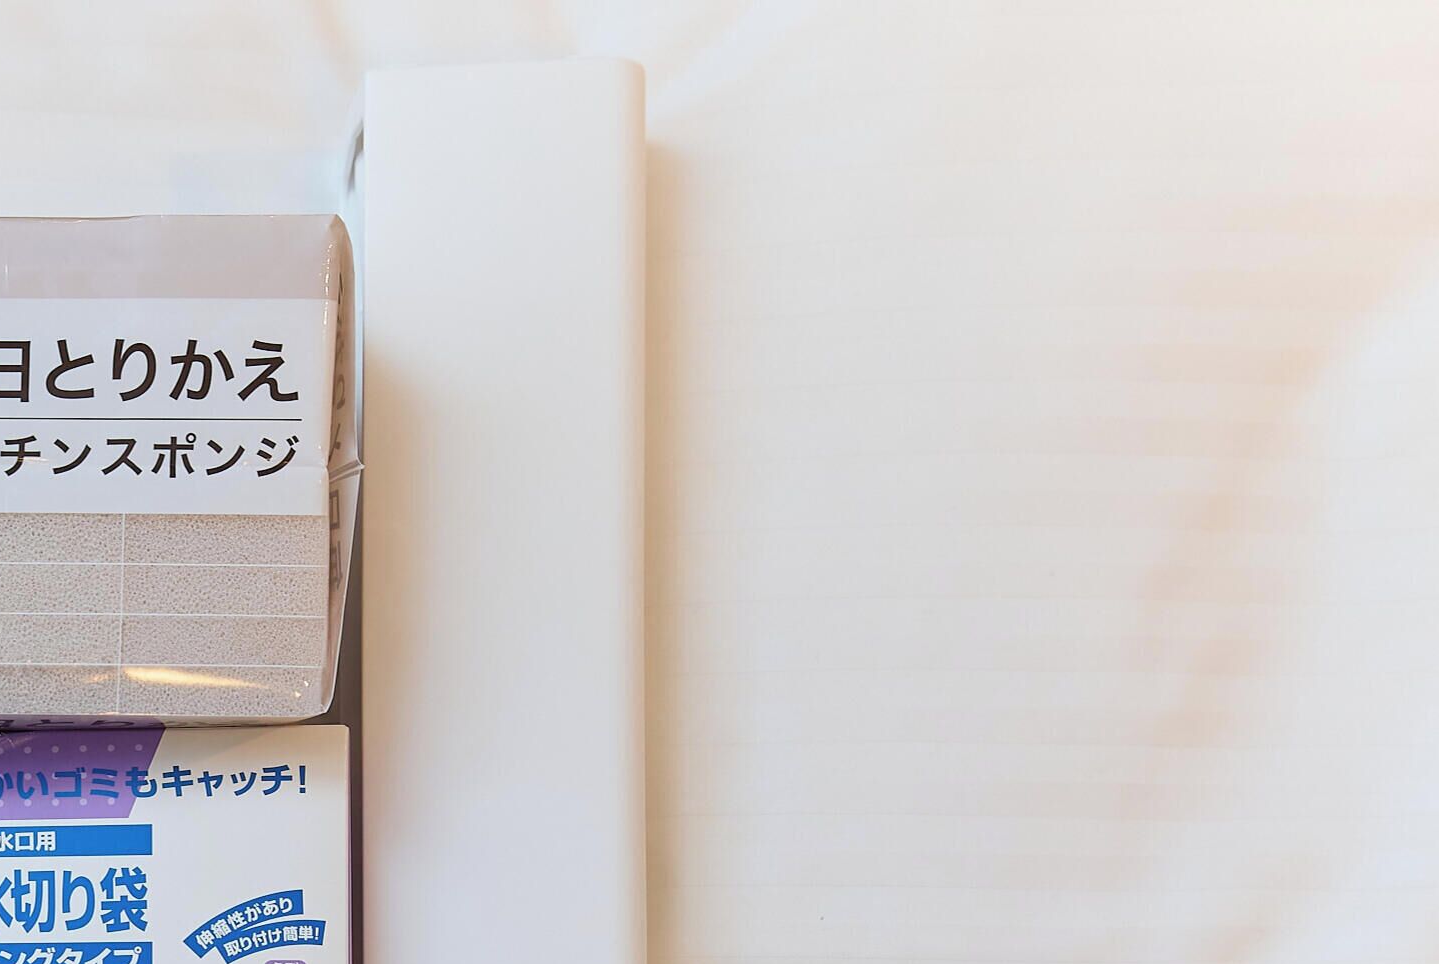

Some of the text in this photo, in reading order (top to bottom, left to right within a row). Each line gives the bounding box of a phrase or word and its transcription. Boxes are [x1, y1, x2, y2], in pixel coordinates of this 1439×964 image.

[195, 897, 293, 949] 伸縮性があり
[223, 926, 319, 957] 取り付け簡単!
